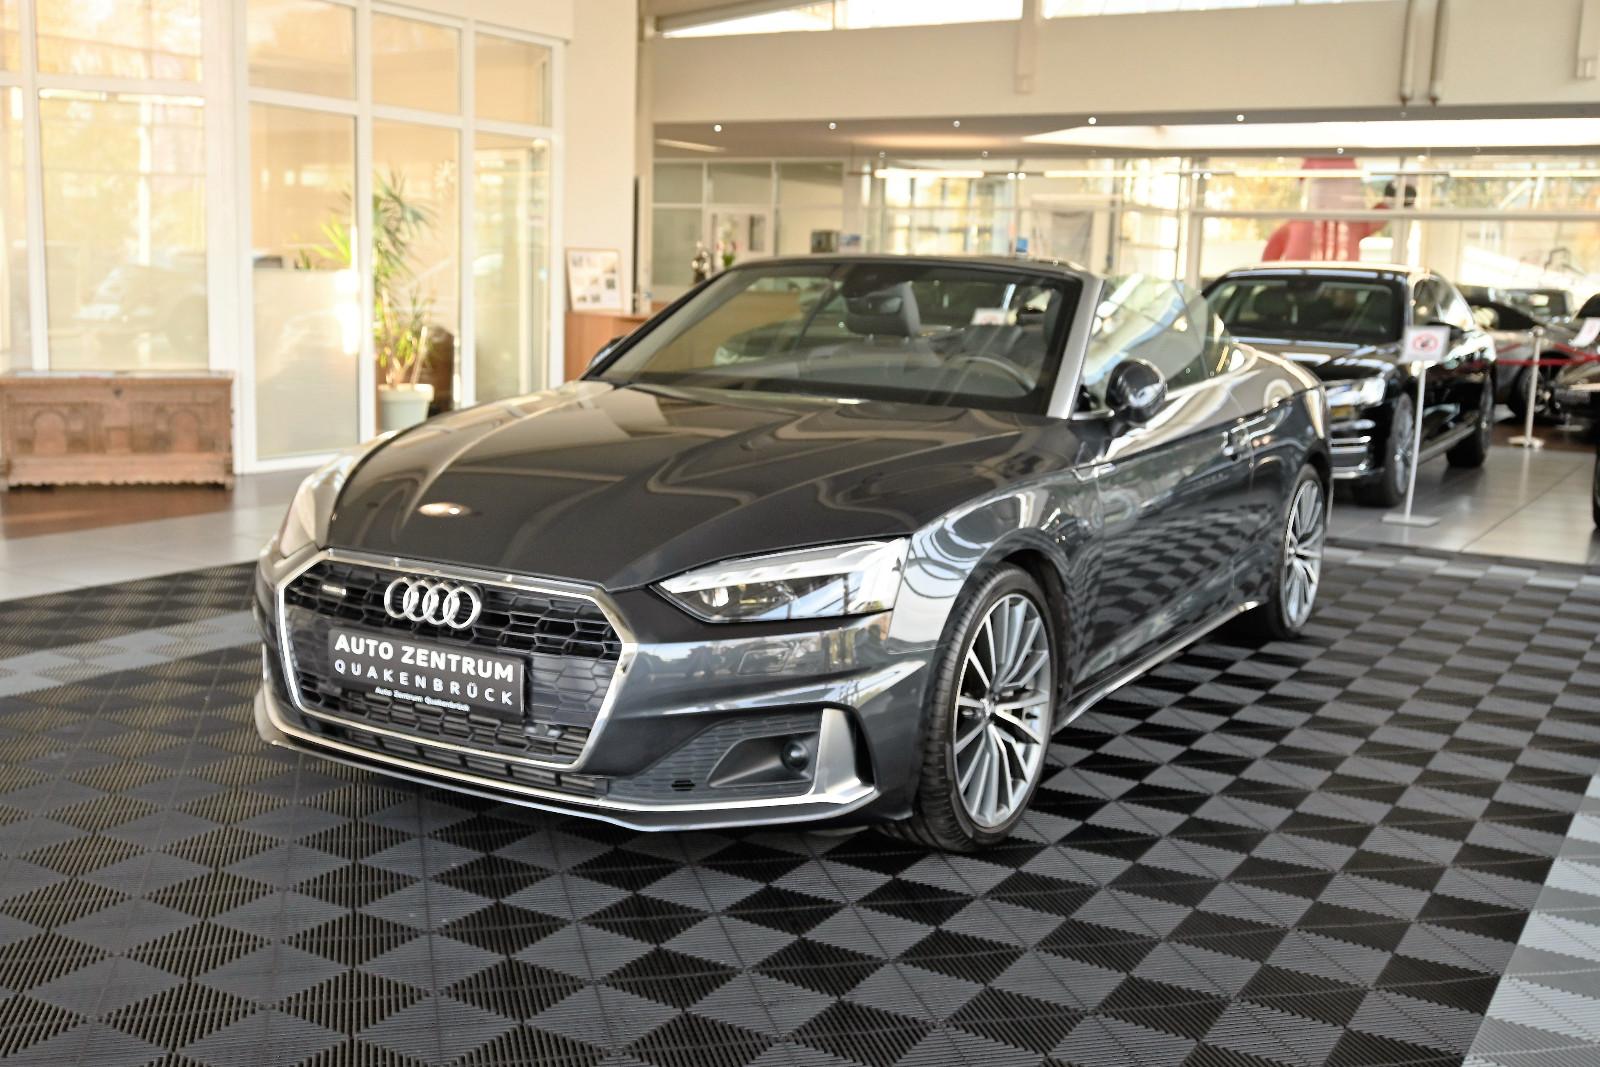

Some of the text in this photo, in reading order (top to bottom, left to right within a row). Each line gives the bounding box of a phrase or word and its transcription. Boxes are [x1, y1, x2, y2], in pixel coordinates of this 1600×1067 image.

[334, 633, 514, 683] AUTO ZENTRUM
[334, 659, 513, 706] QUAKENBRÜCK
